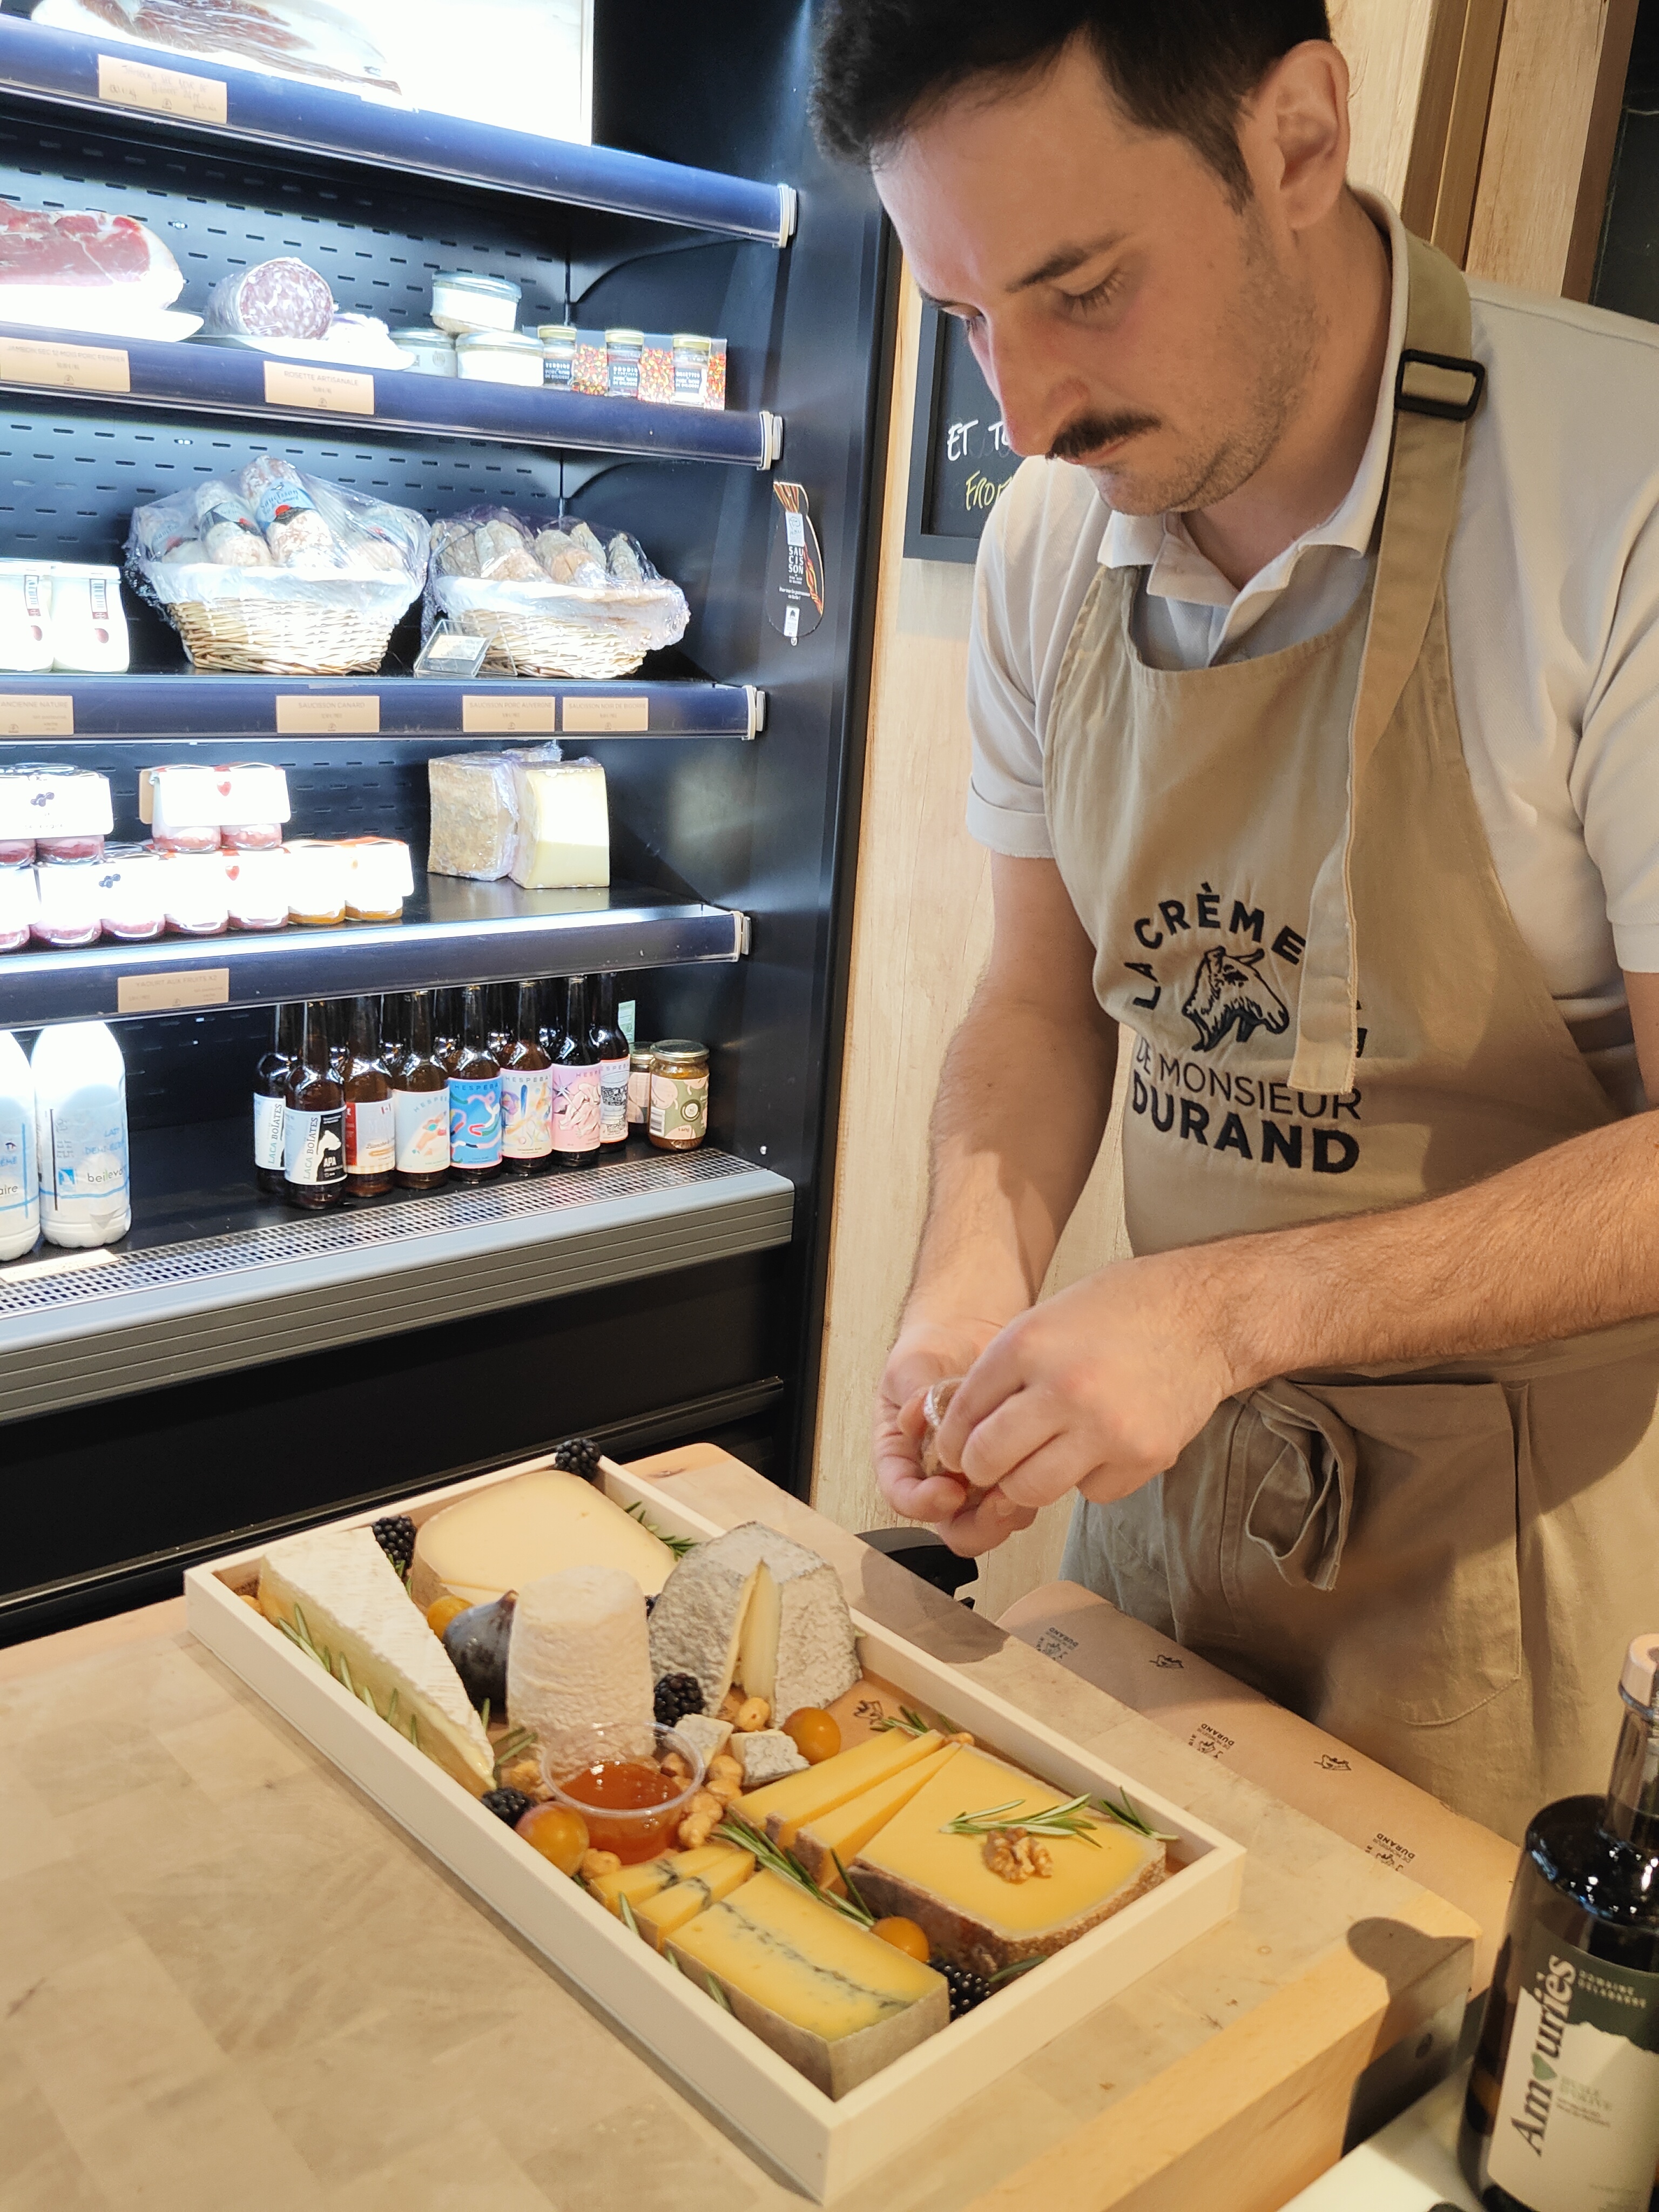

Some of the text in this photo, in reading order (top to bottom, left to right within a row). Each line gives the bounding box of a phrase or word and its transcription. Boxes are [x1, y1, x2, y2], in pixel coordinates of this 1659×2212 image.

[284, 370, 359, 387] ROSETTE ARTISANALE
[947, 419, 979, 462] ET
[788, 545, 804, 557] SAU
[788, 555, 804, 566] CIS
[788, 564, 804, 575] SON
[1124, 962, 1162, 1010] LA
[1136, 1036, 1361, 1120] DE MONSIEUR
[1132, 1069, 1360, 1174] DURAND
[323, 1156, 337, 1168] APA
[1049, 1627, 1079, 1647] DURAND
[1201, 1723, 1235, 1746] DURAND
[1377, 1833, 1416, 1859] DURAND
